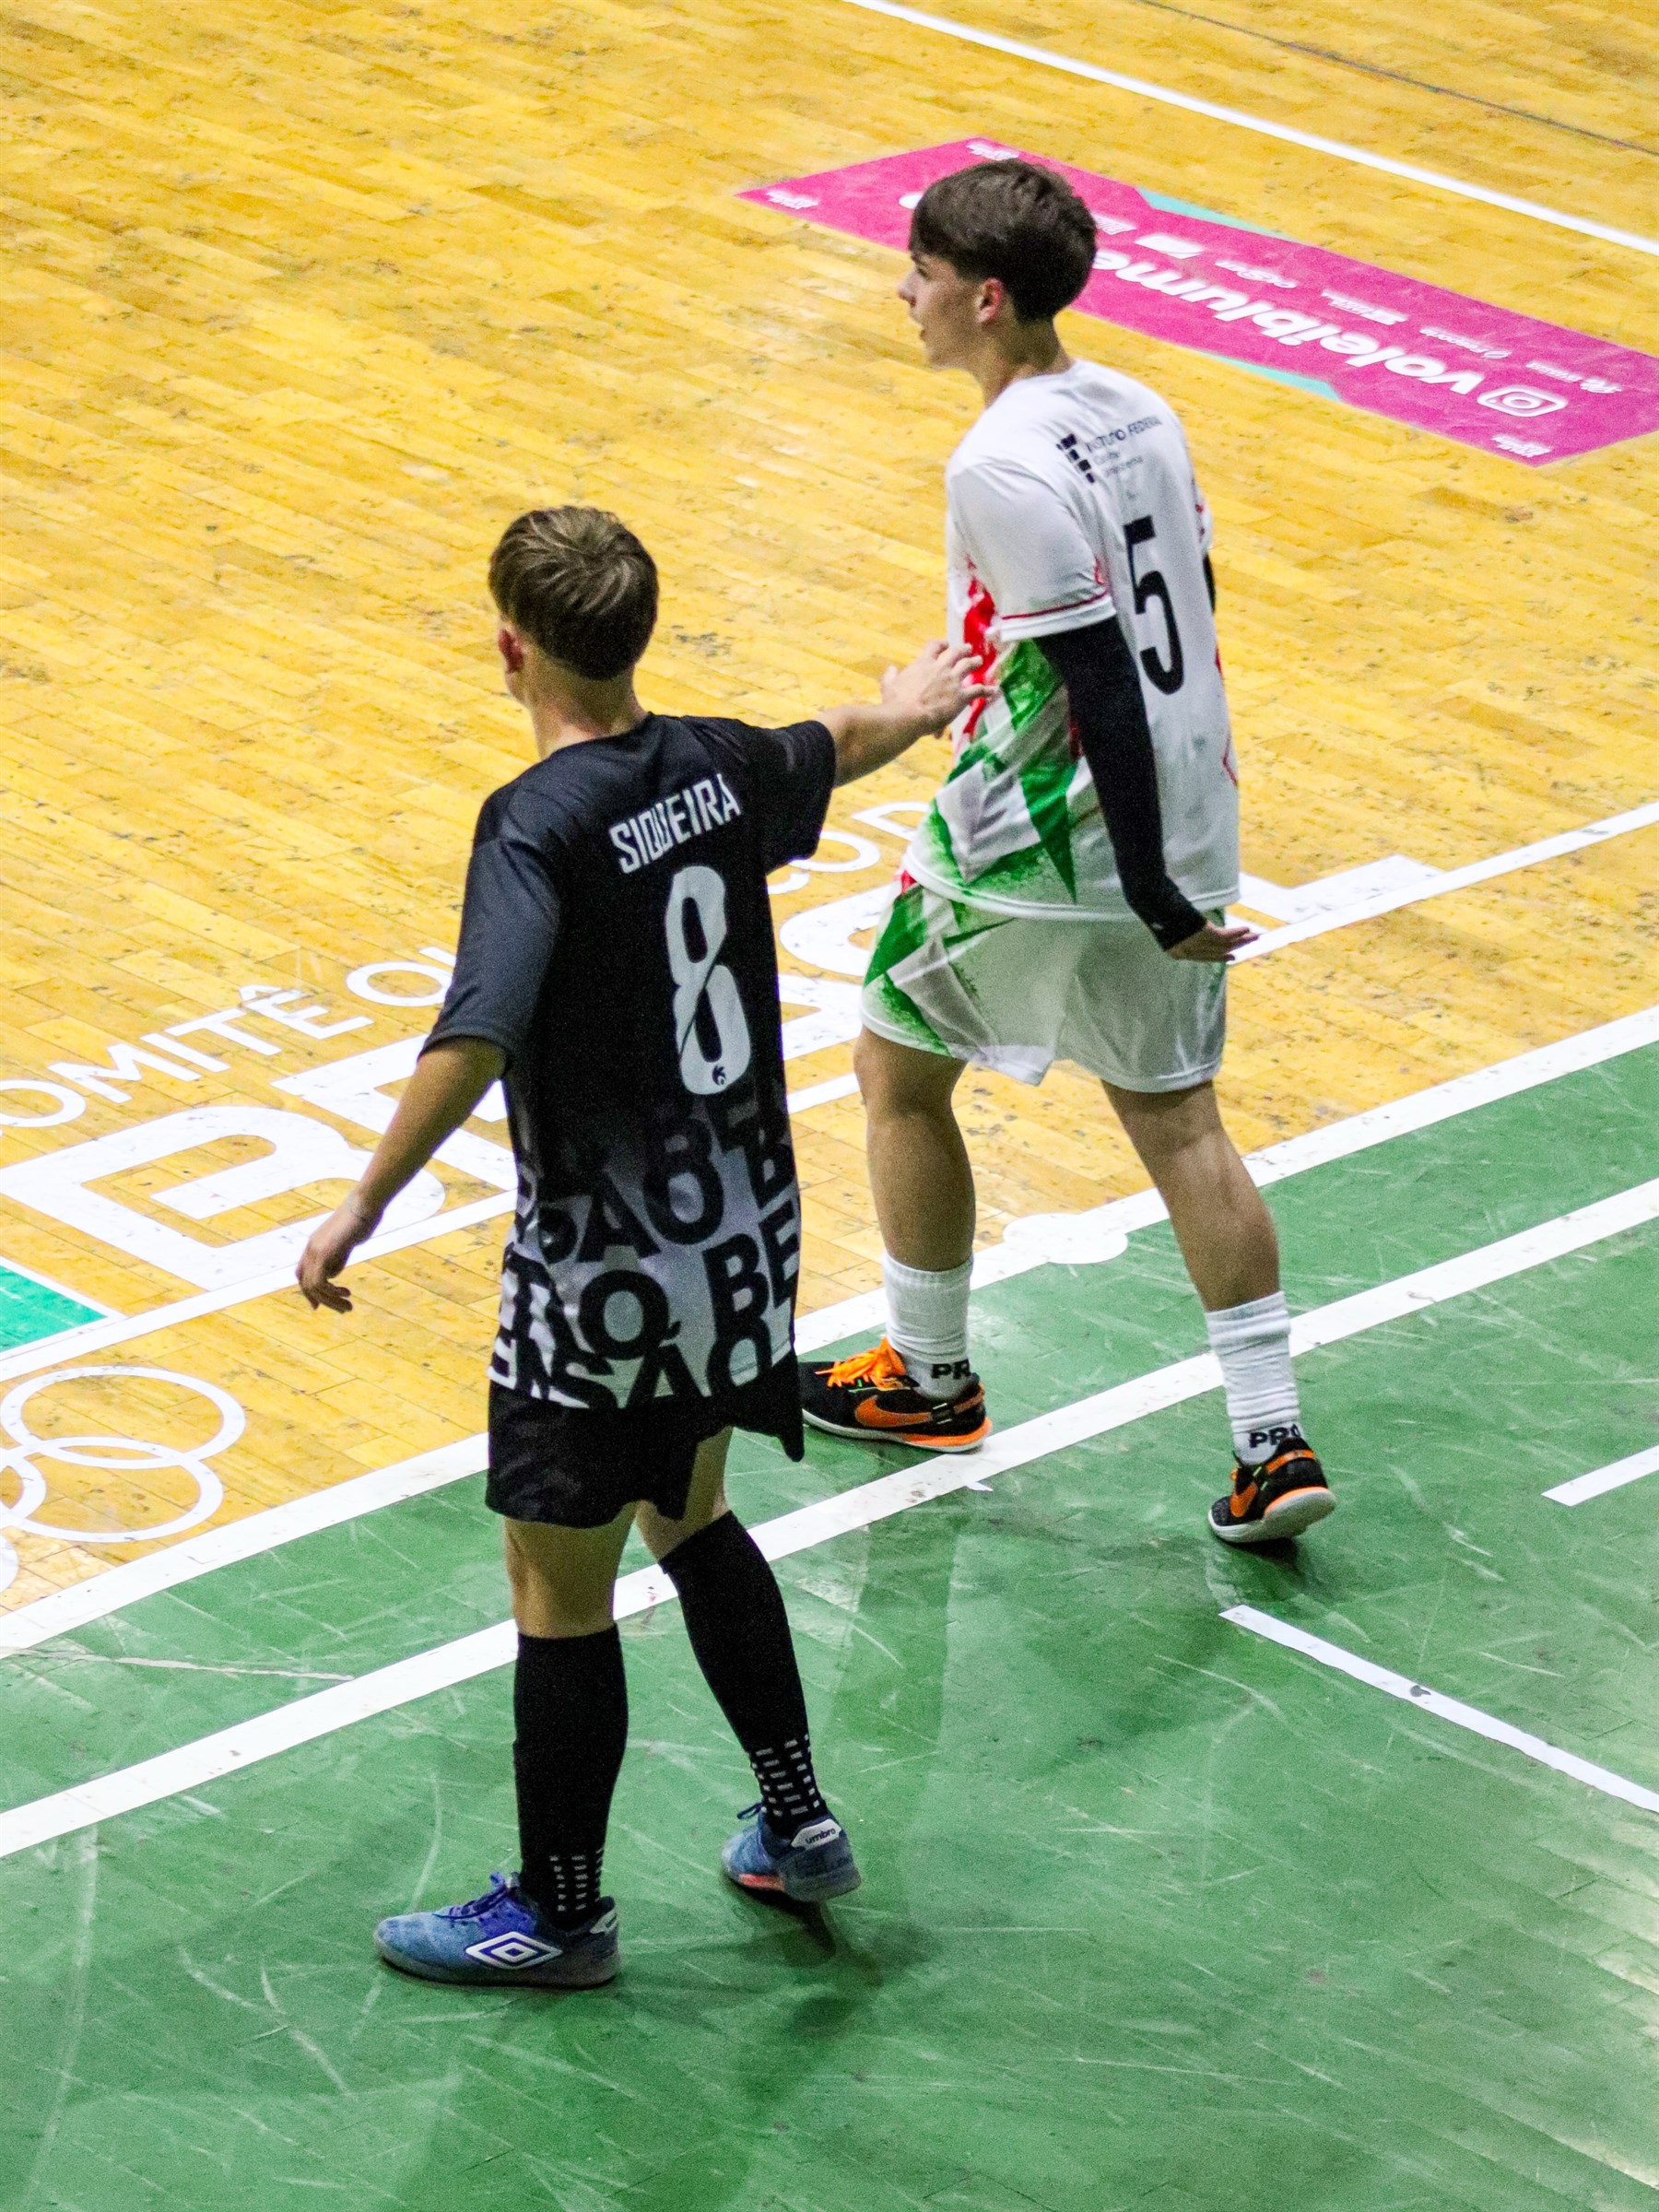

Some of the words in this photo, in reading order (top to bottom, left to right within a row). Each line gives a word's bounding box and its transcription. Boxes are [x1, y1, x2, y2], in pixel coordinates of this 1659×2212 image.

[1093, 250, 1484, 395] voleiblume
[1124, 515, 1183, 695] 5
[608, 772, 741, 874] SIQUEIRA
[665, 865, 751, 1095] 8
[0, 984, 374, 1128] OMITÊ
[805, 1828, 836, 1844] umbro
